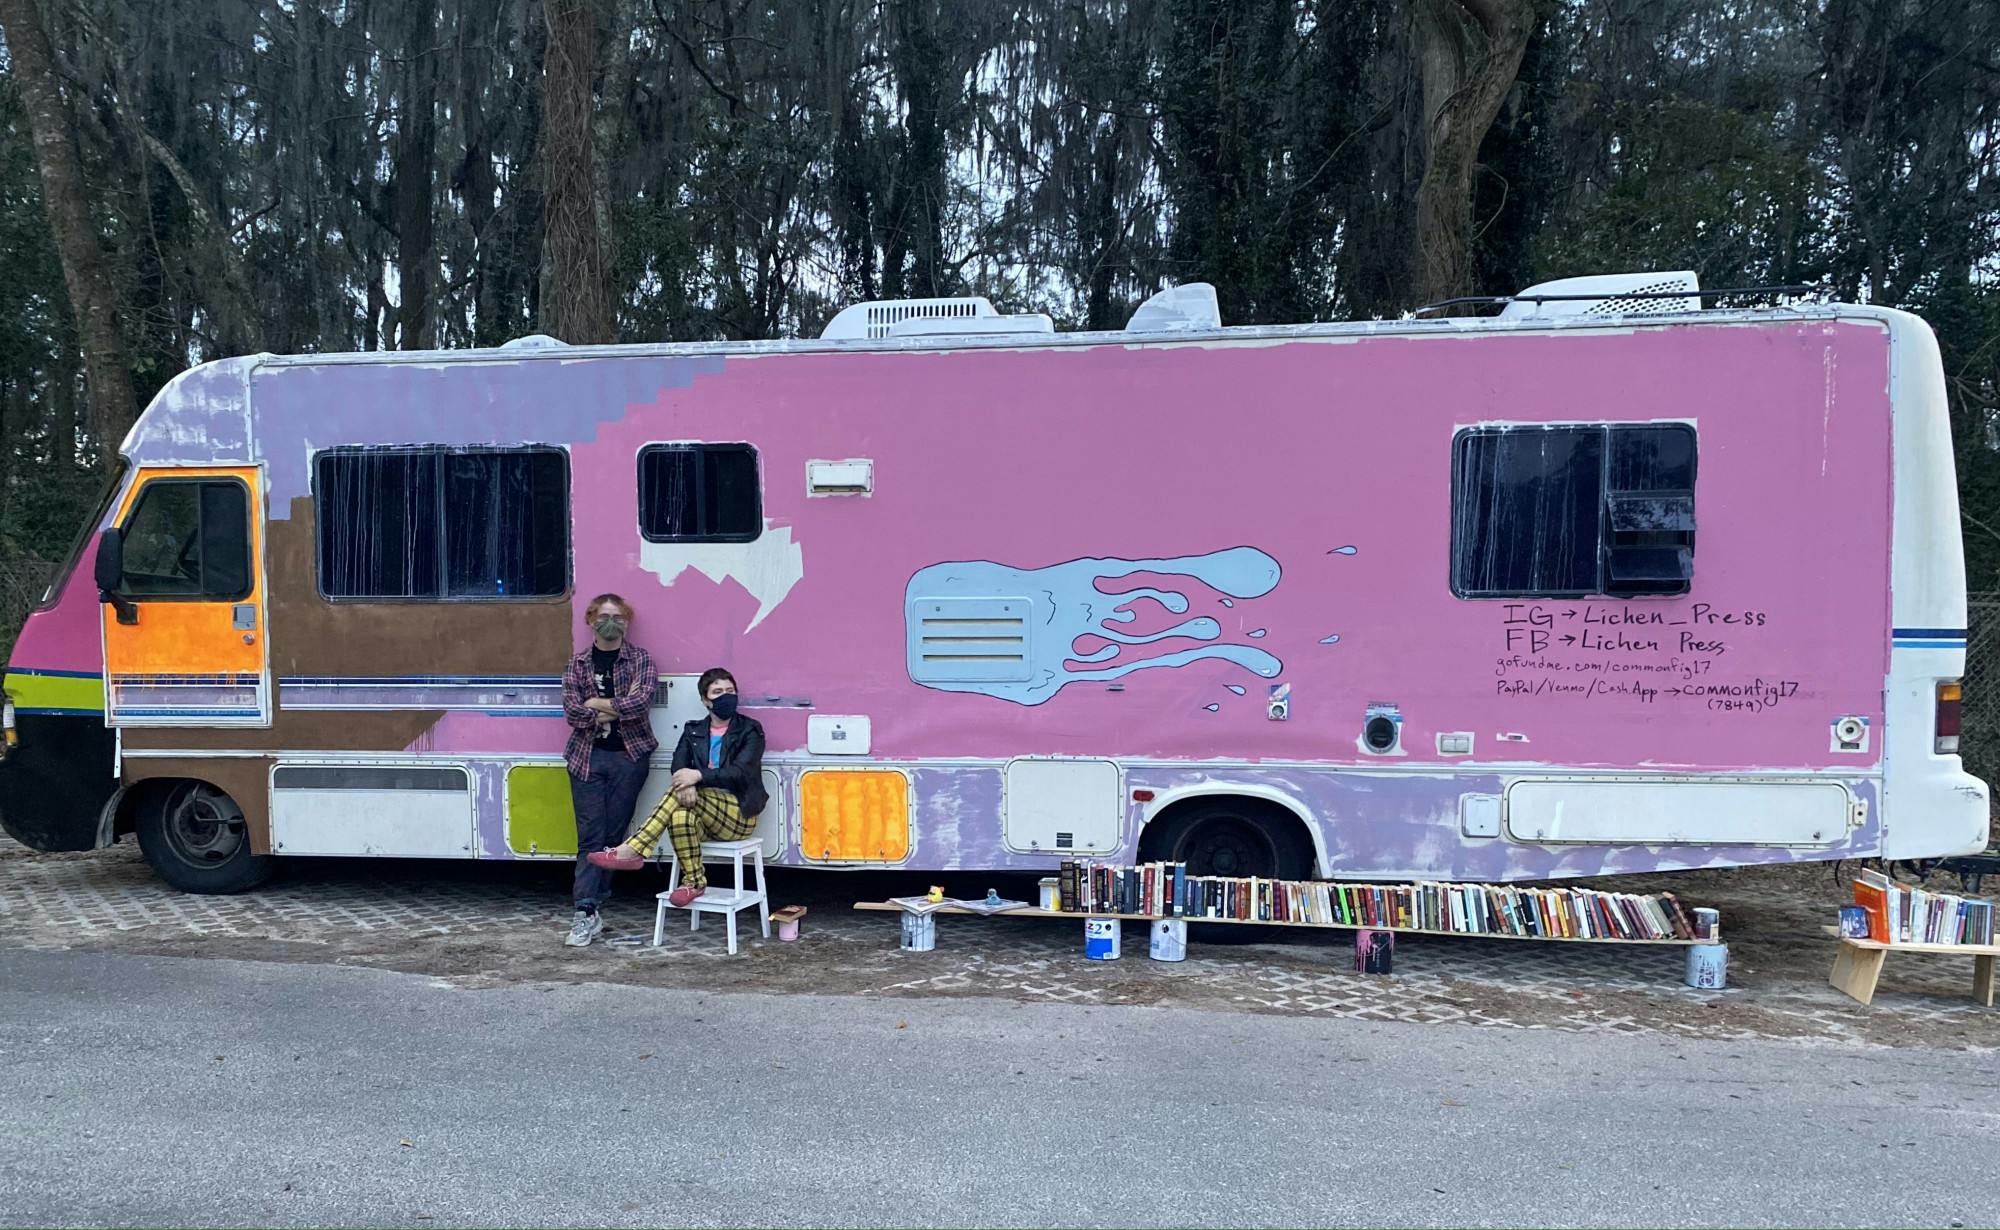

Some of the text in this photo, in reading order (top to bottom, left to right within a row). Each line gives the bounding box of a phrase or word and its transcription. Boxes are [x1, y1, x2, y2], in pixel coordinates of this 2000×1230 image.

[1503, 603, 1766, 629] IG Lichen_Press
[1506, 629, 1725, 656] FB Lichen Press
[1707, 698, 1763, 713] (7849)
